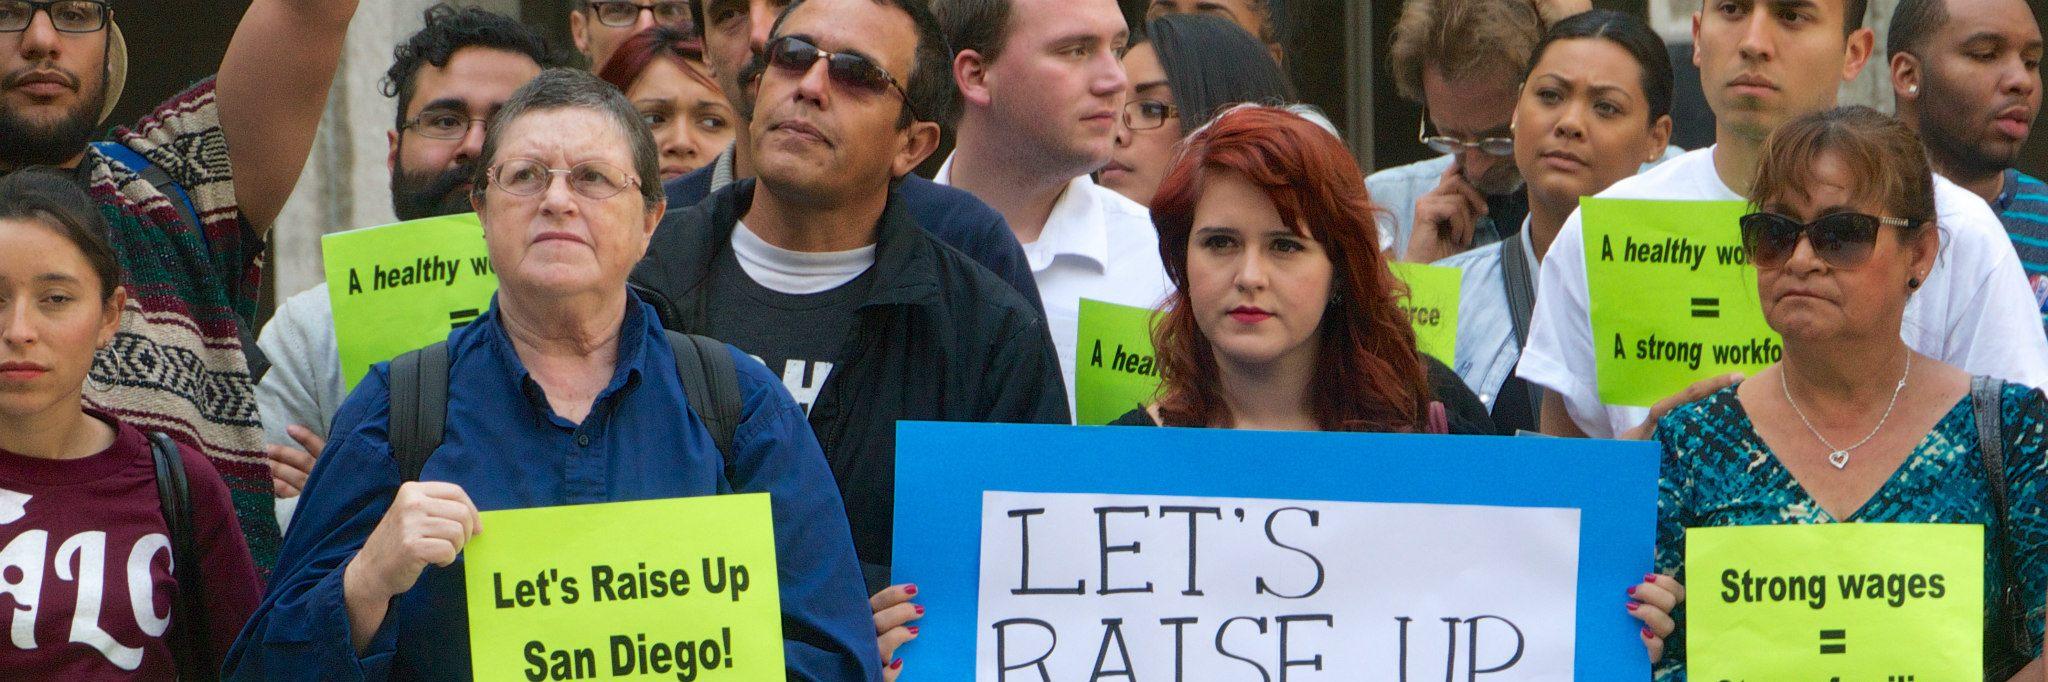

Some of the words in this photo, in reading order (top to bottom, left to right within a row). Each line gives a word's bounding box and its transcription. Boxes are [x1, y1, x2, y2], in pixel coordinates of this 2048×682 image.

[1601, 234, 1614, 262] A
[1624, 236, 1707, 272] healthy
[349, 268, 363, 295] A
[373, 255, 461, 290] healthy
[1090, 339, 1103, 368] A
[1614, 332, 1627, 360] A
[1636, 333, 1704, 371] strong
[1007, 505, 1325, 599] LET'S
[493, 568, 580, 609] Let's
[591, 562, 691, 602] Raise
[702, 556, 750, 602] Up
[1721, 568, 1826, 610] Strong
[1837, 573, 1946, 608] wages
[523, 640, 597, 682] San
[609, 626, 734, 682] Diego!
[991, 613, 1334, 682] RAISE
[1395, 614, 1525, 682] UP
